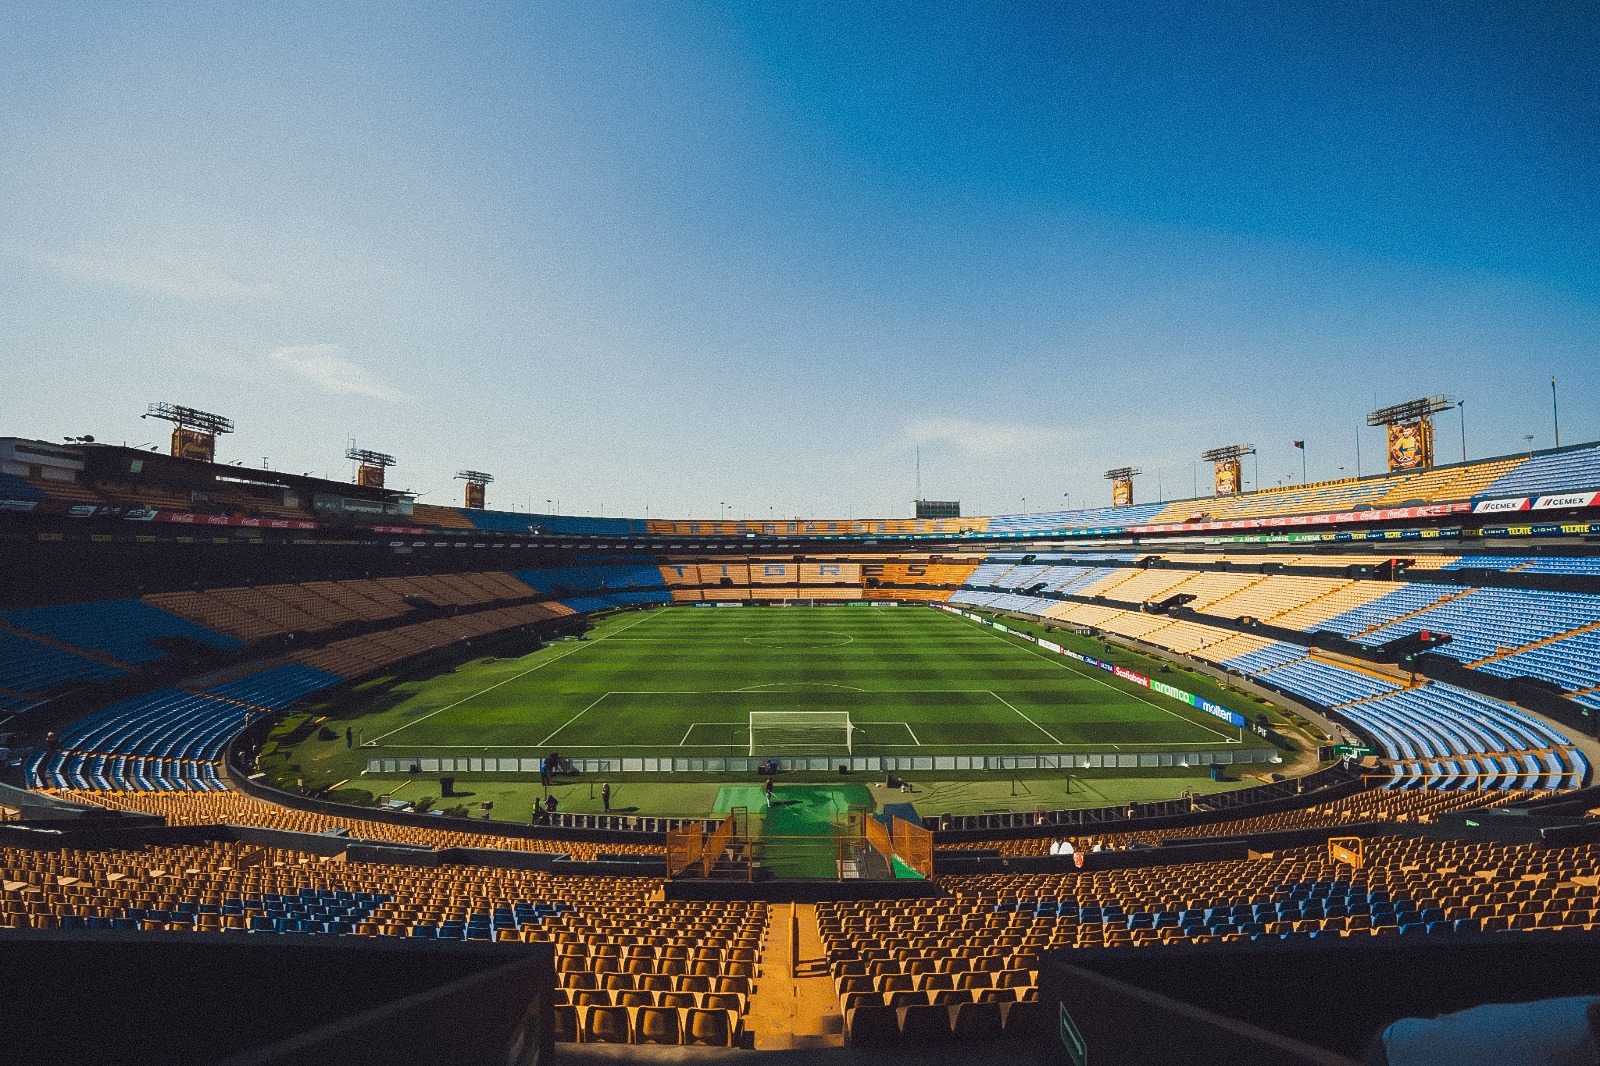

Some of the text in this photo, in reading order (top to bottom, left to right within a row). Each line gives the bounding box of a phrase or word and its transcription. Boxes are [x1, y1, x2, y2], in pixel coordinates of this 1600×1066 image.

[1490, 502, 1517, 510] CEMEX
[1552, 497, 1584, 506] CEMEX
[1507, 526, 1532, 535] TECATE
[1560, 525, 1590, 533] TECATE
[1115, 666, 1149, 688] Scotiabank
[1154, 681, 1190, 703] aramco
[1202, 701, 1232, 723] molten
[1257, 726, 1268, 738] PIF
